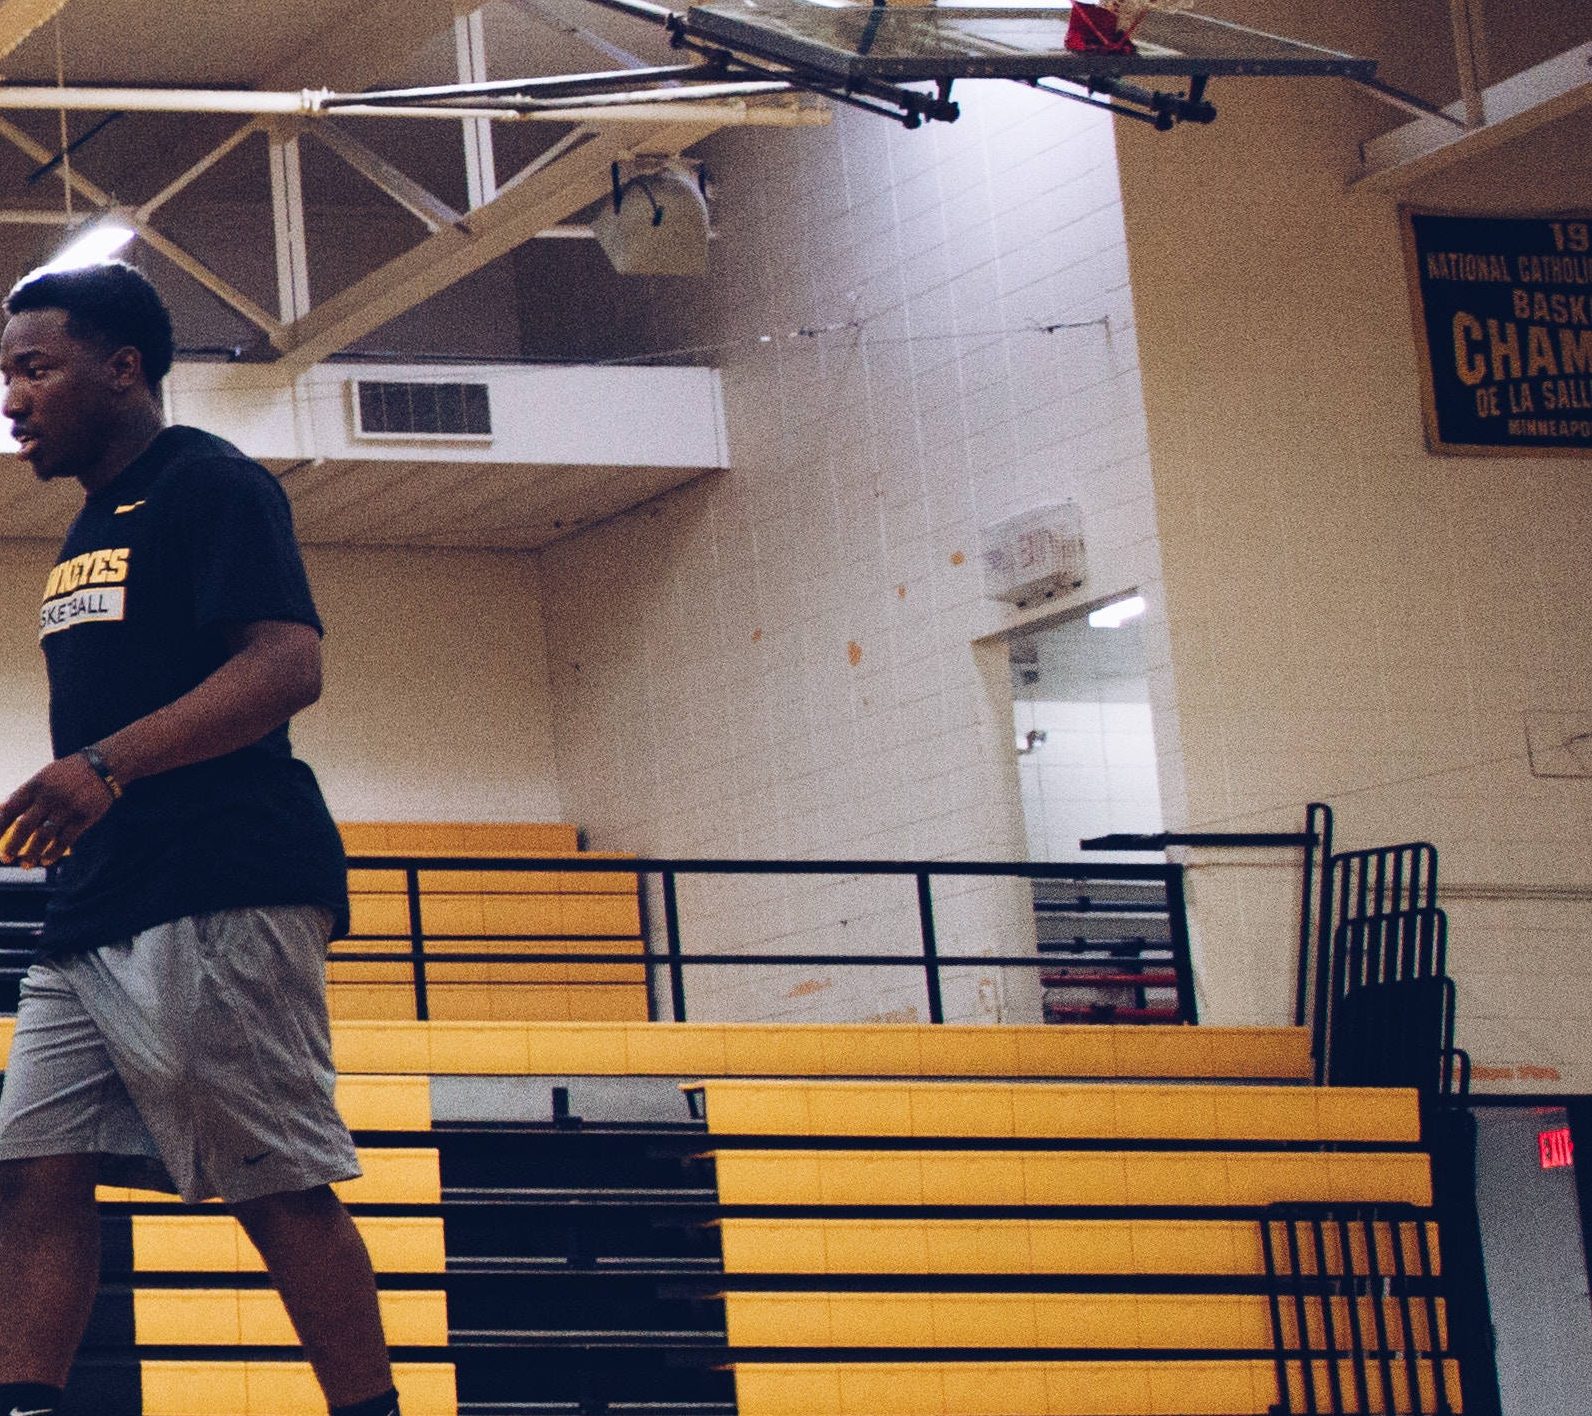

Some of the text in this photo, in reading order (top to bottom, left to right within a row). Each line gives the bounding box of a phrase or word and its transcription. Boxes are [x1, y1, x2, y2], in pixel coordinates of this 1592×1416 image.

[1551, 223, 1590, 252] 19
[1428, 253, 1592, 284] NATIONAL CATHOLI
[1513, 289, 1592, 324] BASK
[1476, 379, 1592, 418] DE LA SALL
[41, 594, 109, 625] SKEBALL
